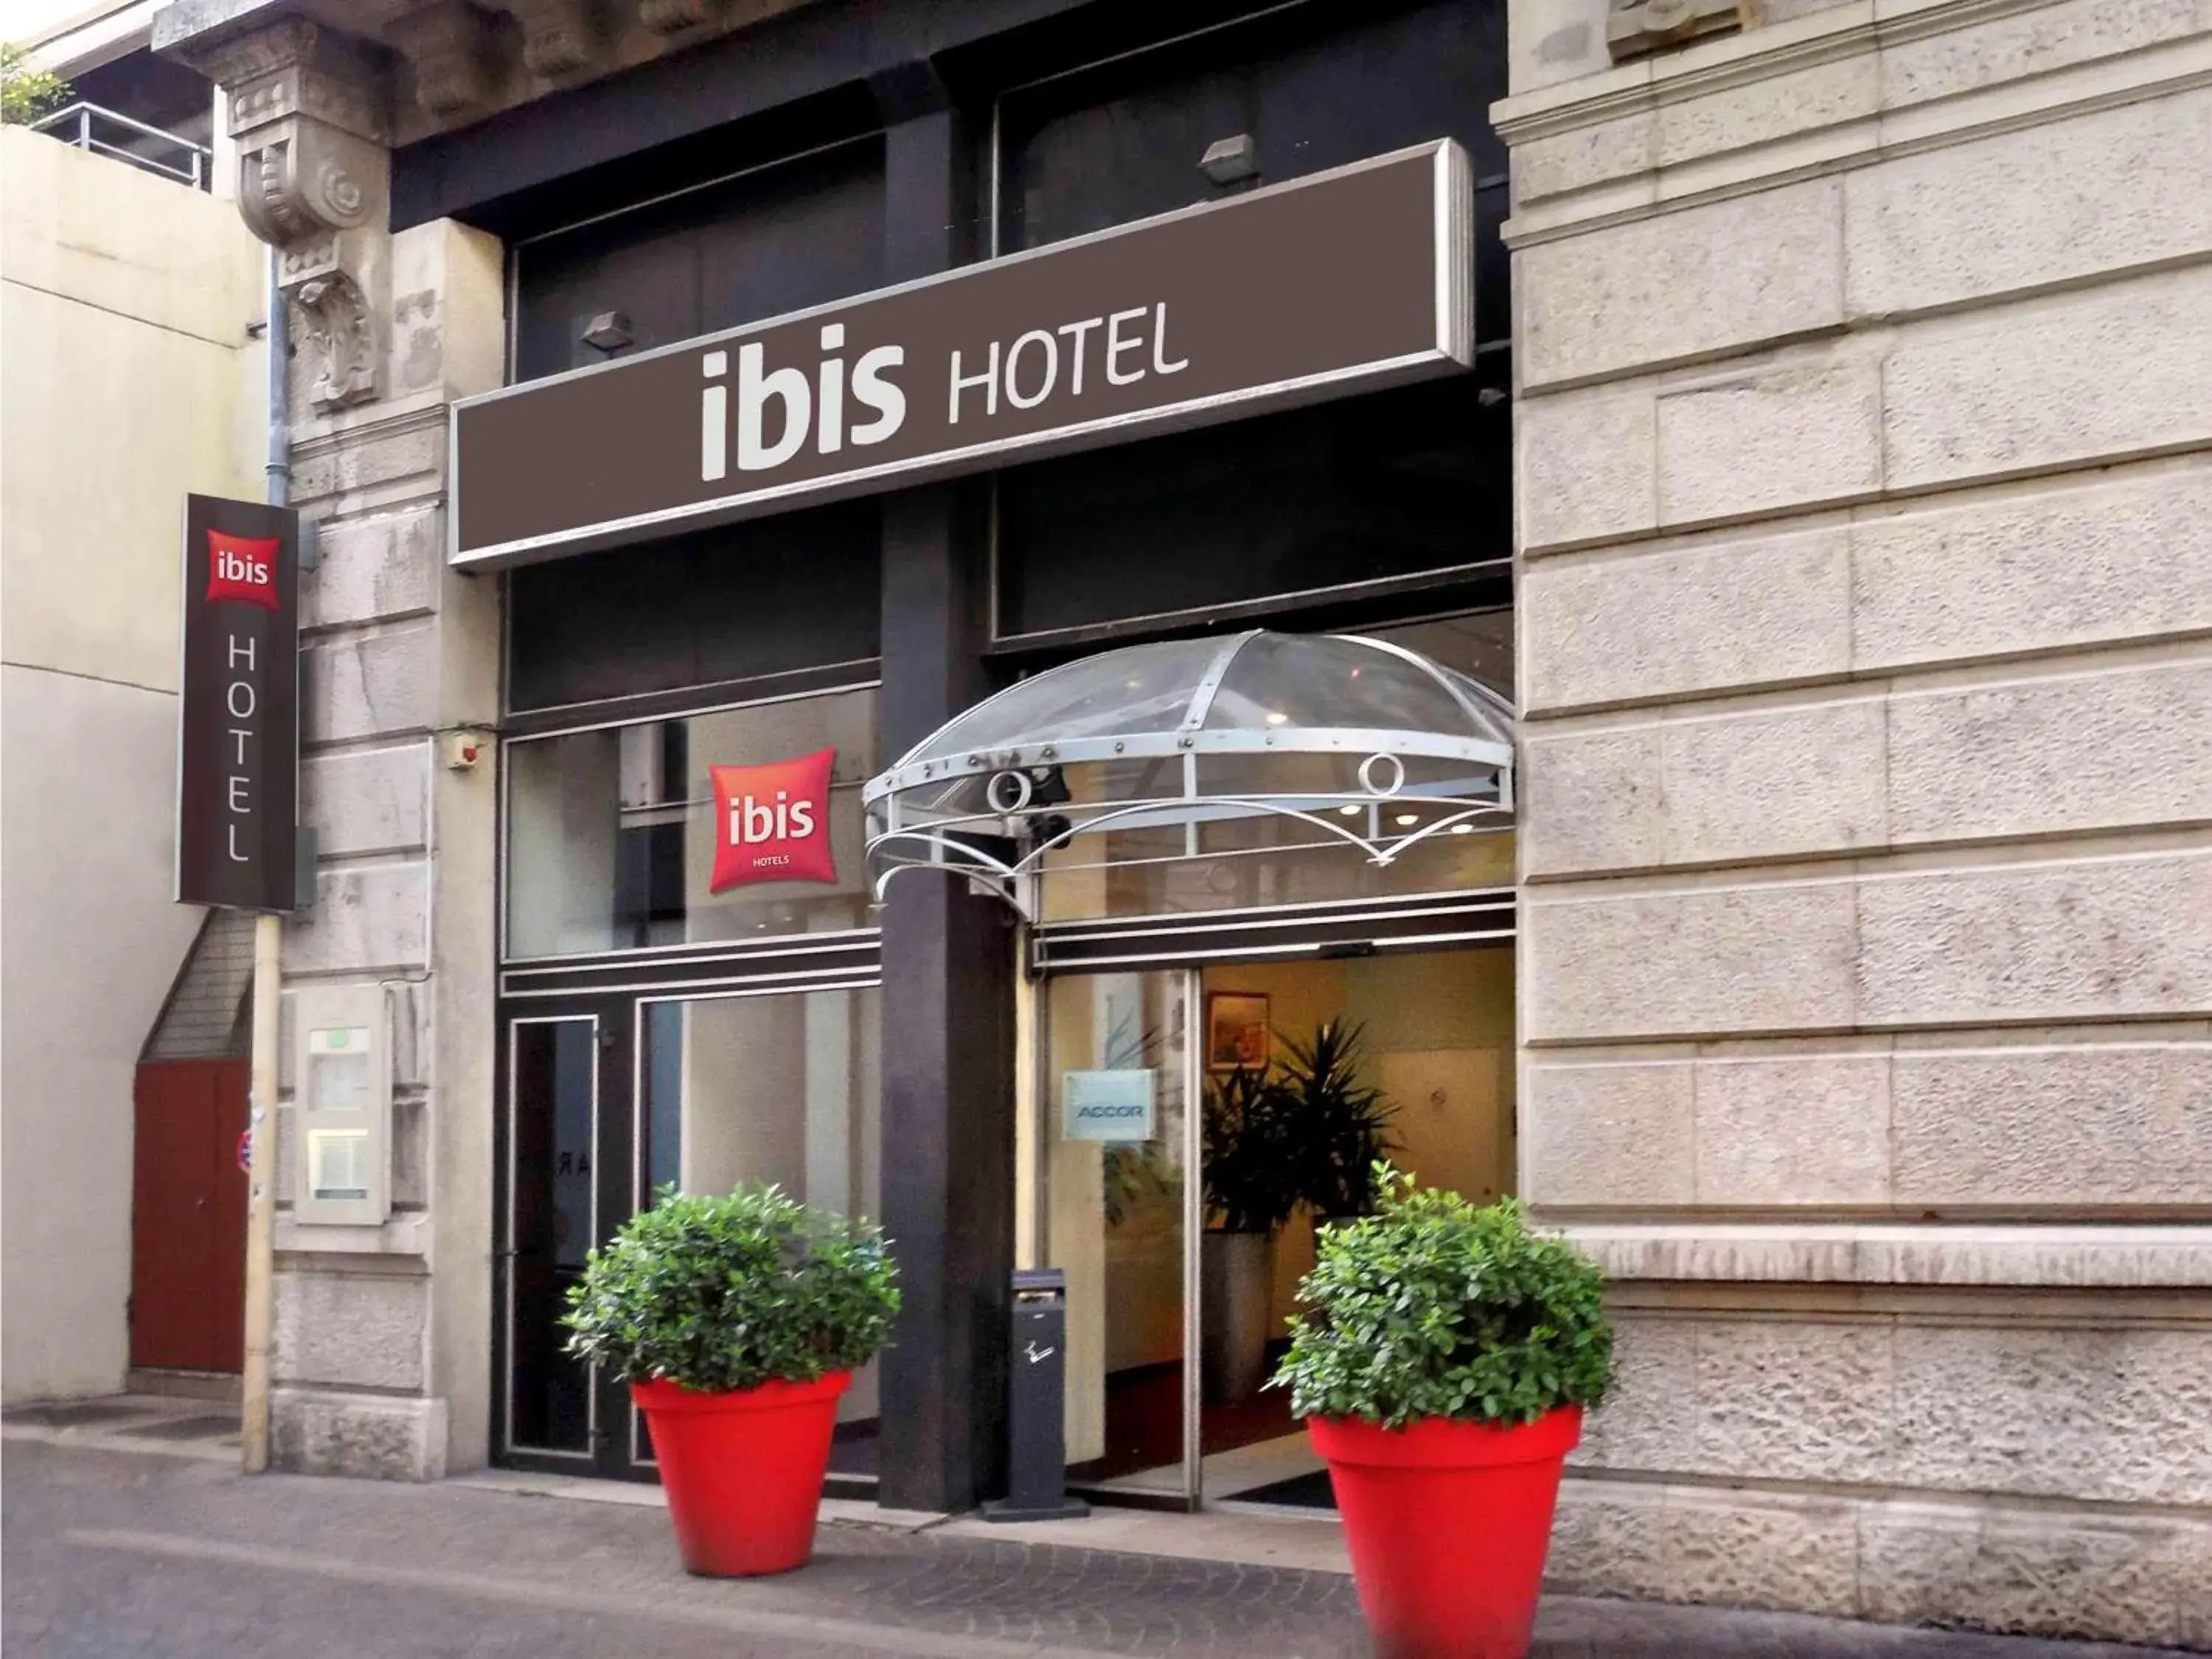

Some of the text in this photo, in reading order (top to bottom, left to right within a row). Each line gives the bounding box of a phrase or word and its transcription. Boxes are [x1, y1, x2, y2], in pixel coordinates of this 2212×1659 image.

[700, 302, 1190, 482] ibis HOTEL
[218, 550, 268, 585] ibis
[226, 634, 256, 862] HOTEL
[729, 790, 814, 846] ibis
[752, 854, 790, 868] HOTELS
[1077, 1105, 1144, 1119] ACCOR
